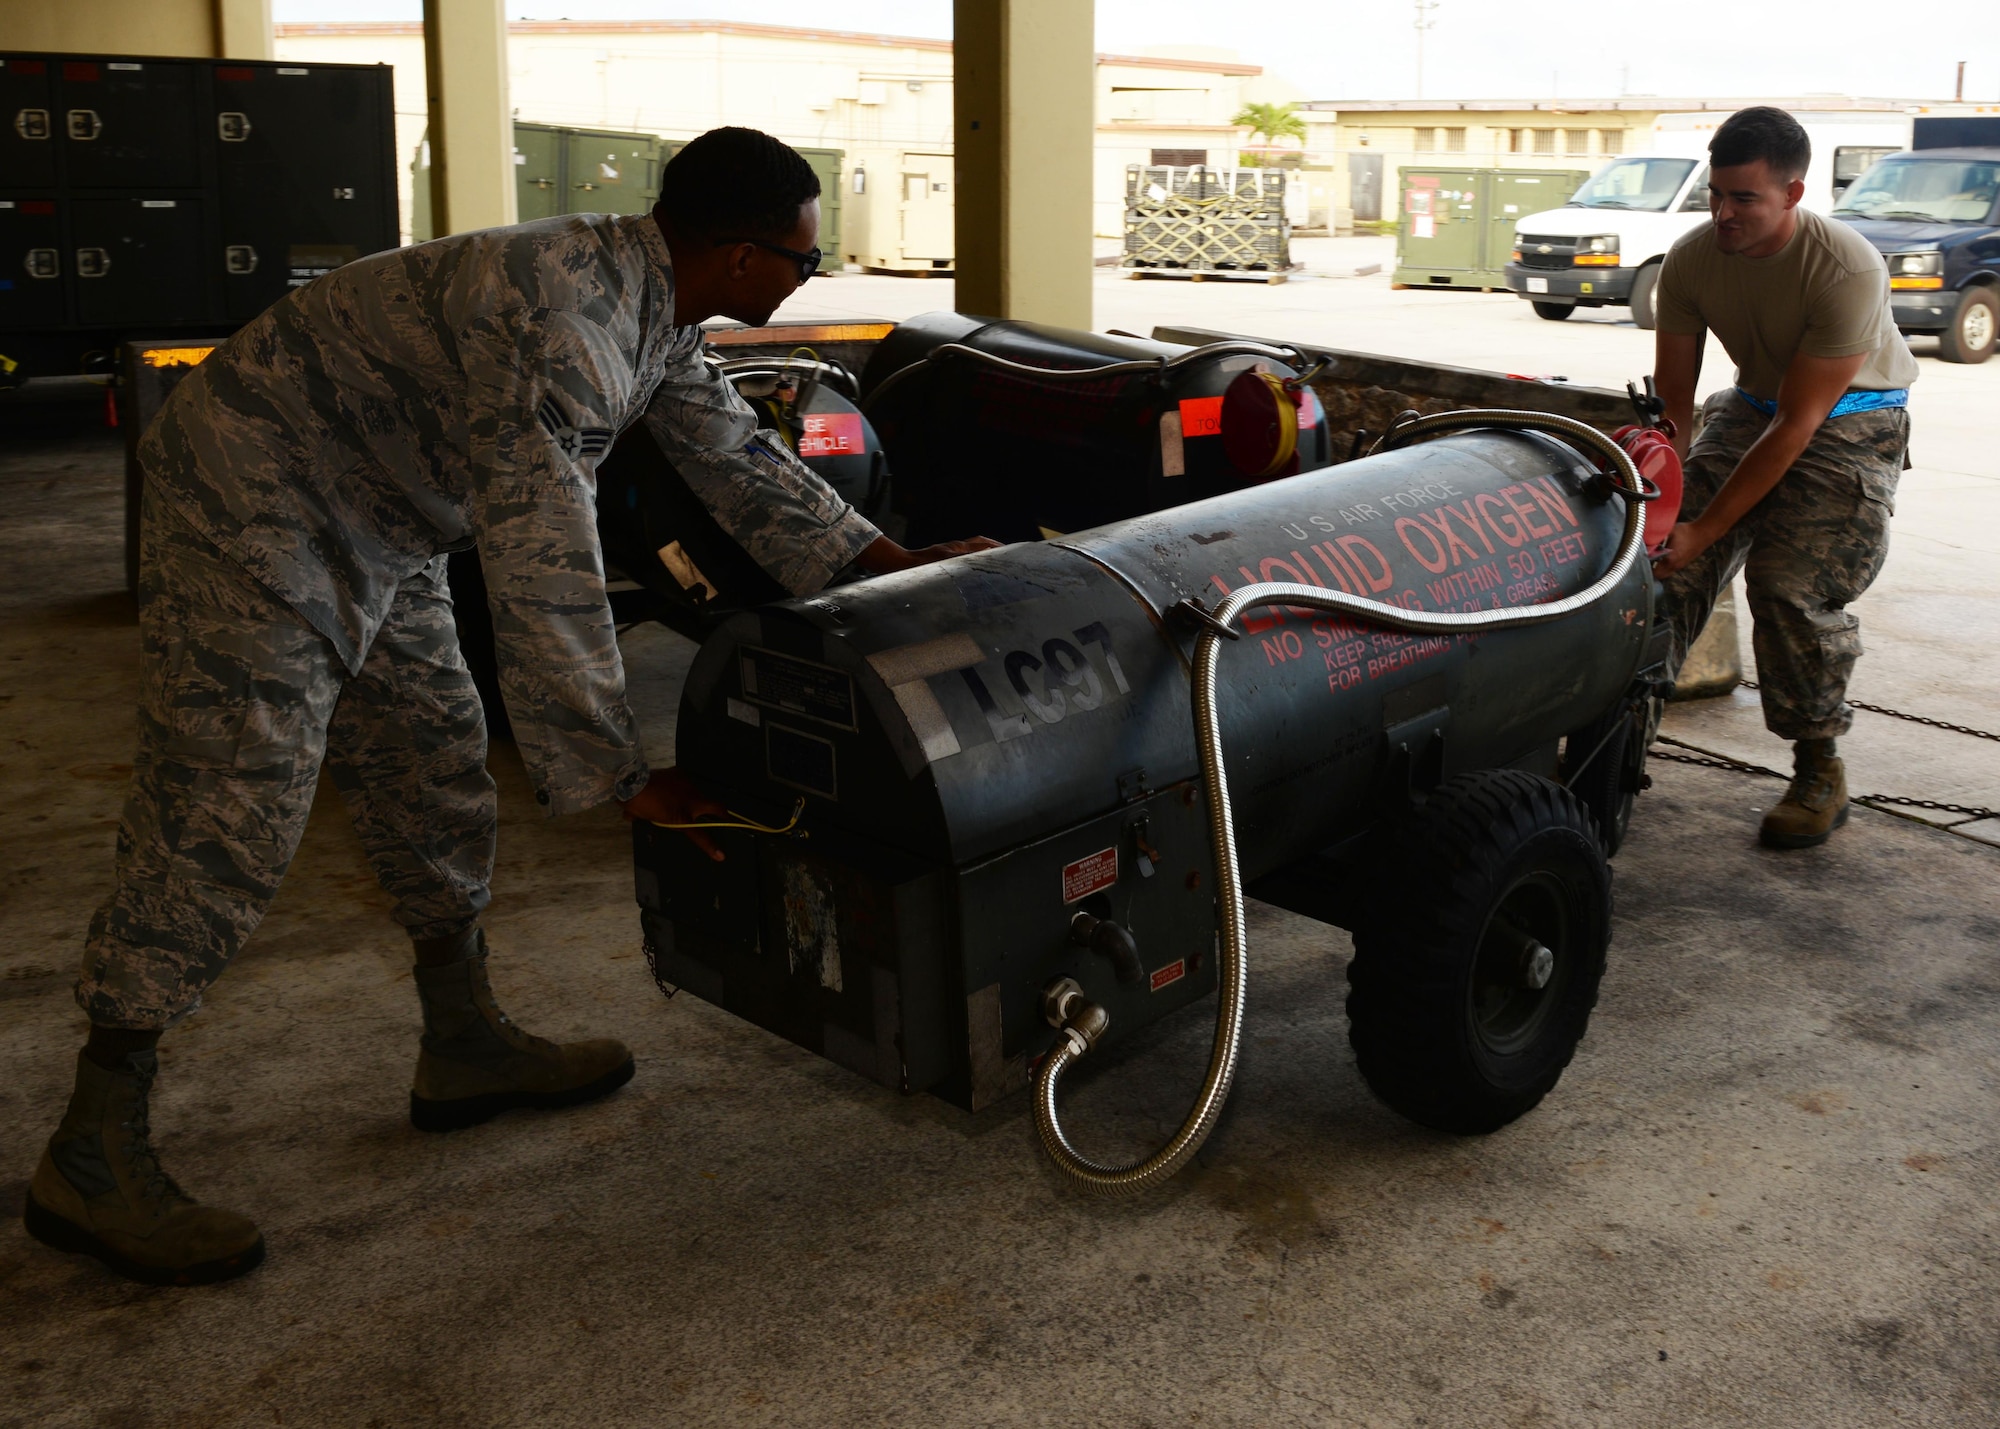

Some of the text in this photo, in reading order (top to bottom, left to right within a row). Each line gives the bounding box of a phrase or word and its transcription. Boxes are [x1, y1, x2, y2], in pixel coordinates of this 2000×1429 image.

[798, 436, 849, 452] EHICLE
[803, 418, 827, 433] GE
[1280, 480, 1463, 541] U S AIR FORCE
[1394, 476, 1579, 574] OXYGEN
[1261, 532, 1588, 666] NO SMONG WITHIN 50 FEET
[1323, 640, 1366, 672] KEEP
[1370, 629, 1412, 655] FREE
[1492, 592, 1502, 609] &
[1506, 572, 1560, 604] GREASE
[959, 622, 1132, 744] LC97
[1328, 634, 1451, 694] FOR BREATHING
